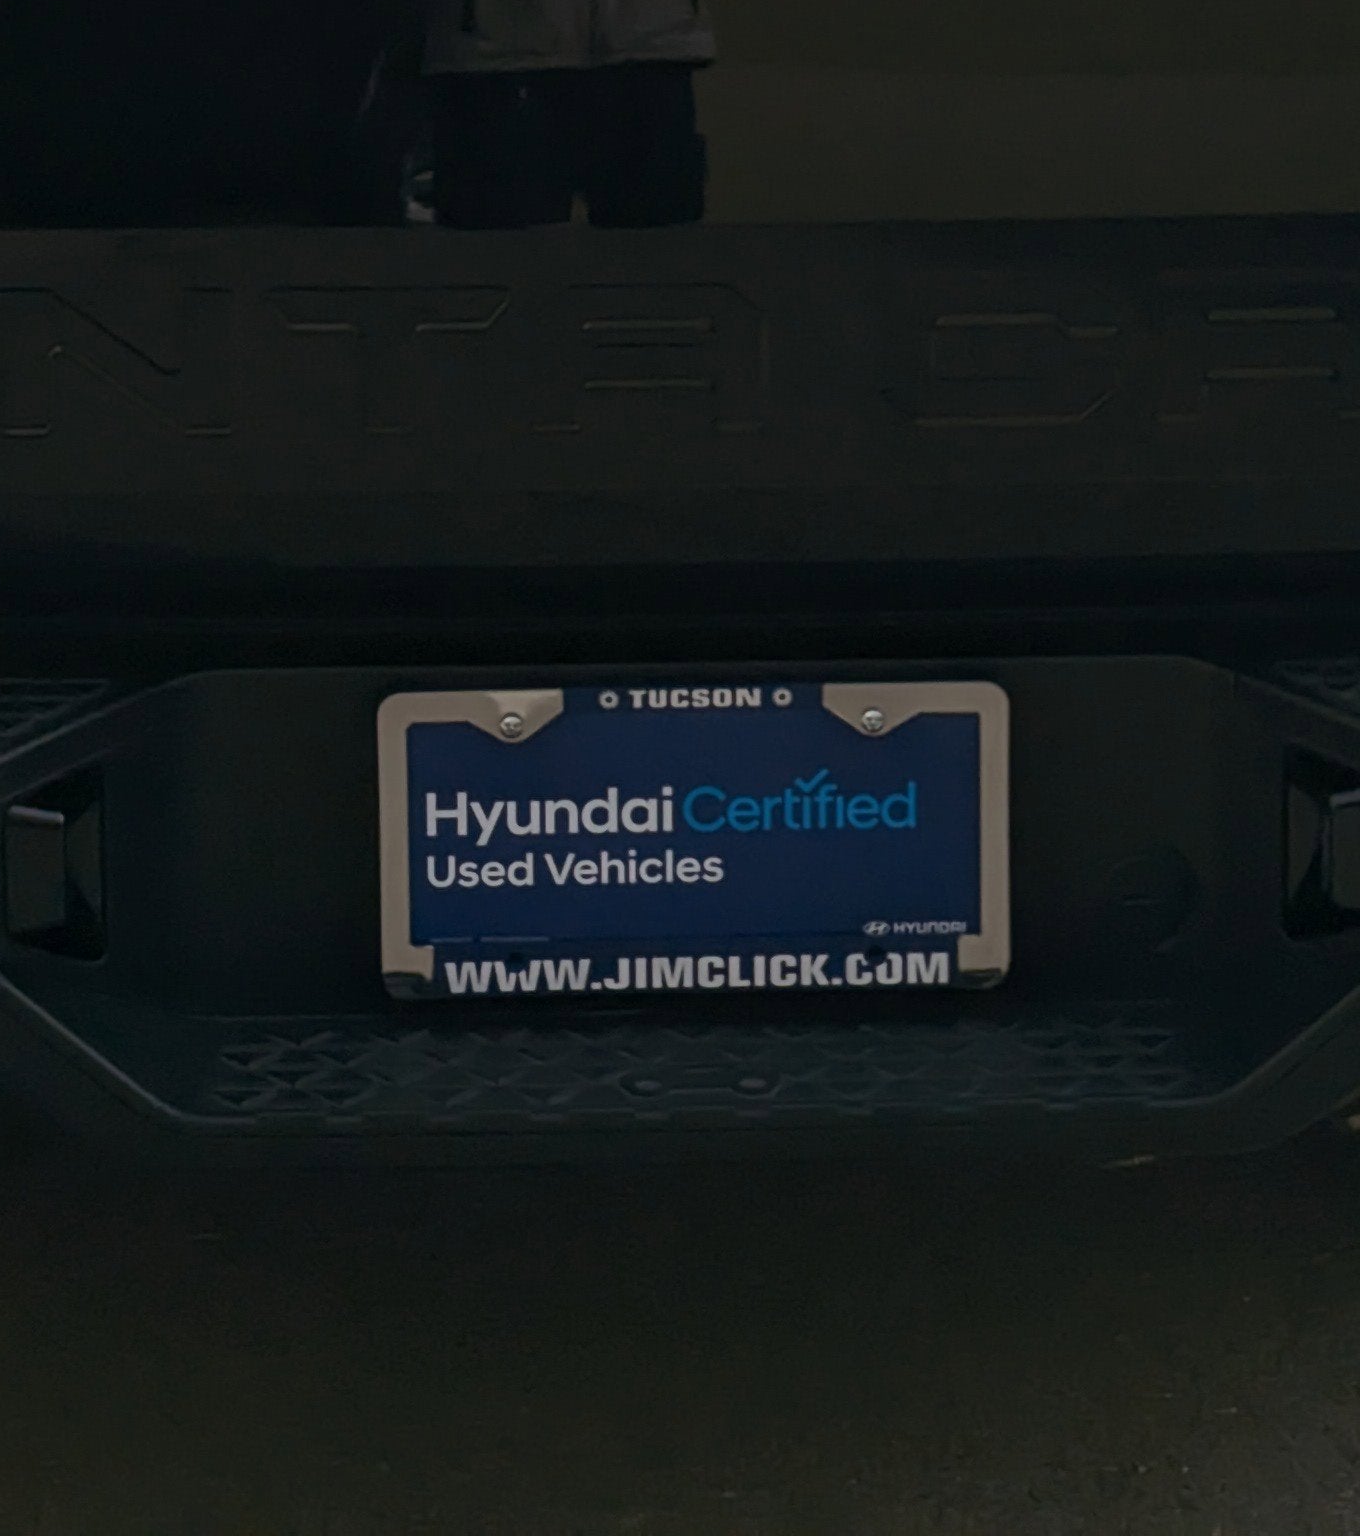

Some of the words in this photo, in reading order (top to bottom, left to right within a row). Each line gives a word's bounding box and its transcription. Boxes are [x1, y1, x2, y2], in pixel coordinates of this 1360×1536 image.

[628, 687, 762, 709] TUCSON
[425, 786, 675, 846] Hyundai
[682, 769, 918, 833] Certified
[426, 853, 535, 888] Used
[544, 849, 725, 886] Vehicles
[893, 920, 968, 935] HYUNDAI
[444, 951, 950, 994] WWW.JIMCLICK.COM
